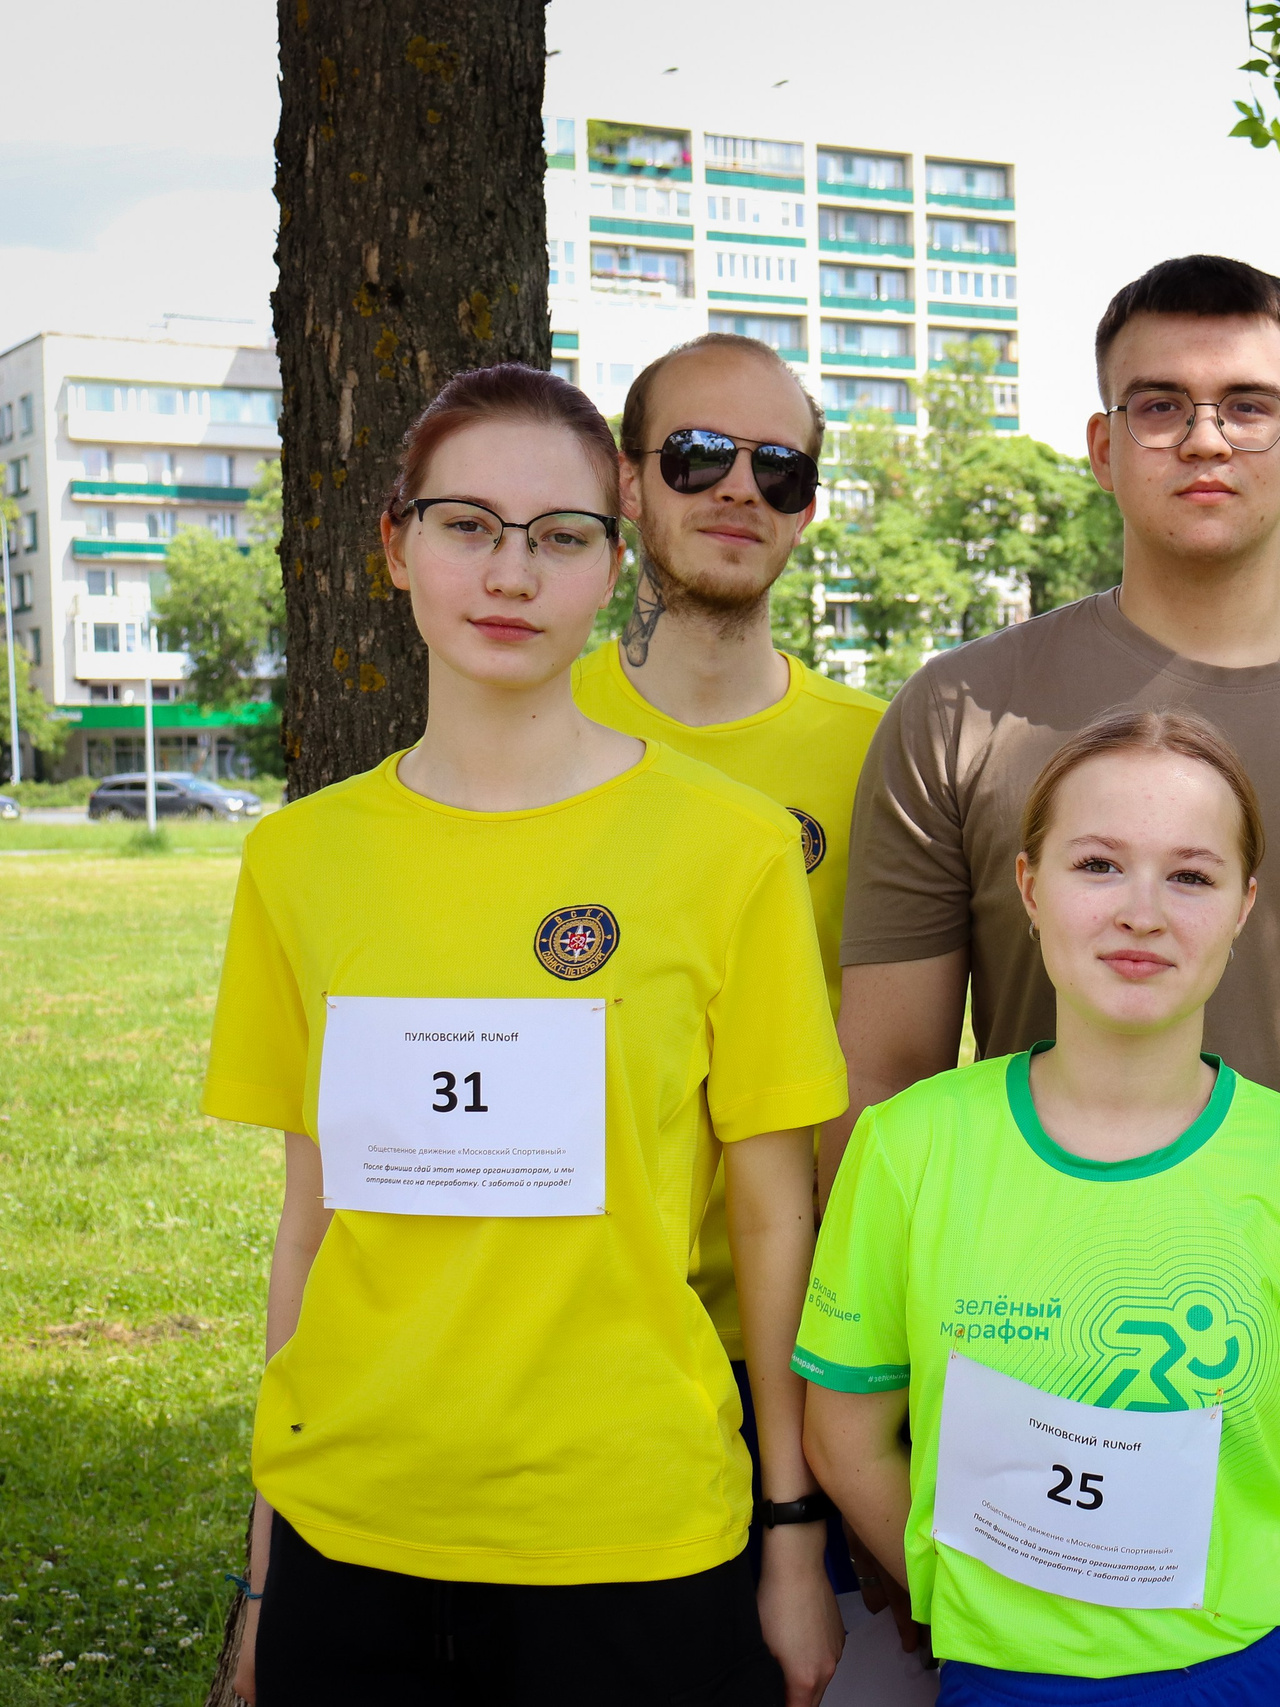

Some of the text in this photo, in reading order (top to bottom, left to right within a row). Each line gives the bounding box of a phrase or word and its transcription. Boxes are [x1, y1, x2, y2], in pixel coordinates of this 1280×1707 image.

[542, 950, 605, 976] САНКТ-ПЕТЕРБУРГ
[404, 1030, 519, 1042] ПУЛКОВСКИЙ RUNoff
[432, 1071, 489, 1113] 31
[367, 1144, 566, 1156] Общественное движение «Московский Спортивный»
[363, 1162, 383, 1171] После
[384, 1164, 412, 1173] финиша
[414, 1165, 431, 1173] сдай
[456, 1167, 481, 1175] номер
[482, 1167, 552, 1175] организаторам,
[365, 1176, 401, 1185] отправим
[426, 1179, 479, 1188] переработку.
[488, 1179, 525, 1187] заботой
[533, 1178, 572, 1188] природе!
[812, 1277, 837, 1303] Вклад
[808, 1293, 861, 1322] в будущее
[954, 1294, 1062, 1319] зелёный
[940, 1318, 1049, 1344] марафон
[1029, 1417, 1142, 1452] ПУЛКОВСКИЙ RUNoff
[1047, 1464, 1104, 1510] 25
[981, 1499, 1174, 1555] Общественное движение «Московский Спортивный»
[973, 1512, 993, 1527] После
[993, 1524, 1019, 1542] финиша
[1020, 1539, 1037, 1550] сдай
[1038, 1546, 1060, 1558] этот
[1061, 1553, 1088, 1565] номер
[1089, 1559, 1157, 1572] организаторам,
[974, 1526, 1007, 1548] отправим
[1007, 1545, 1019, 1554] его
[1019, 1551, 1029, 1559] на
[1030, 1554, 1084, 1575] переработку.
[1086, 1569, 1092, 1577] С
[1093, 1571, 1130, 1583] заботой
[1137, 1575, 1175, 1584] природе!
